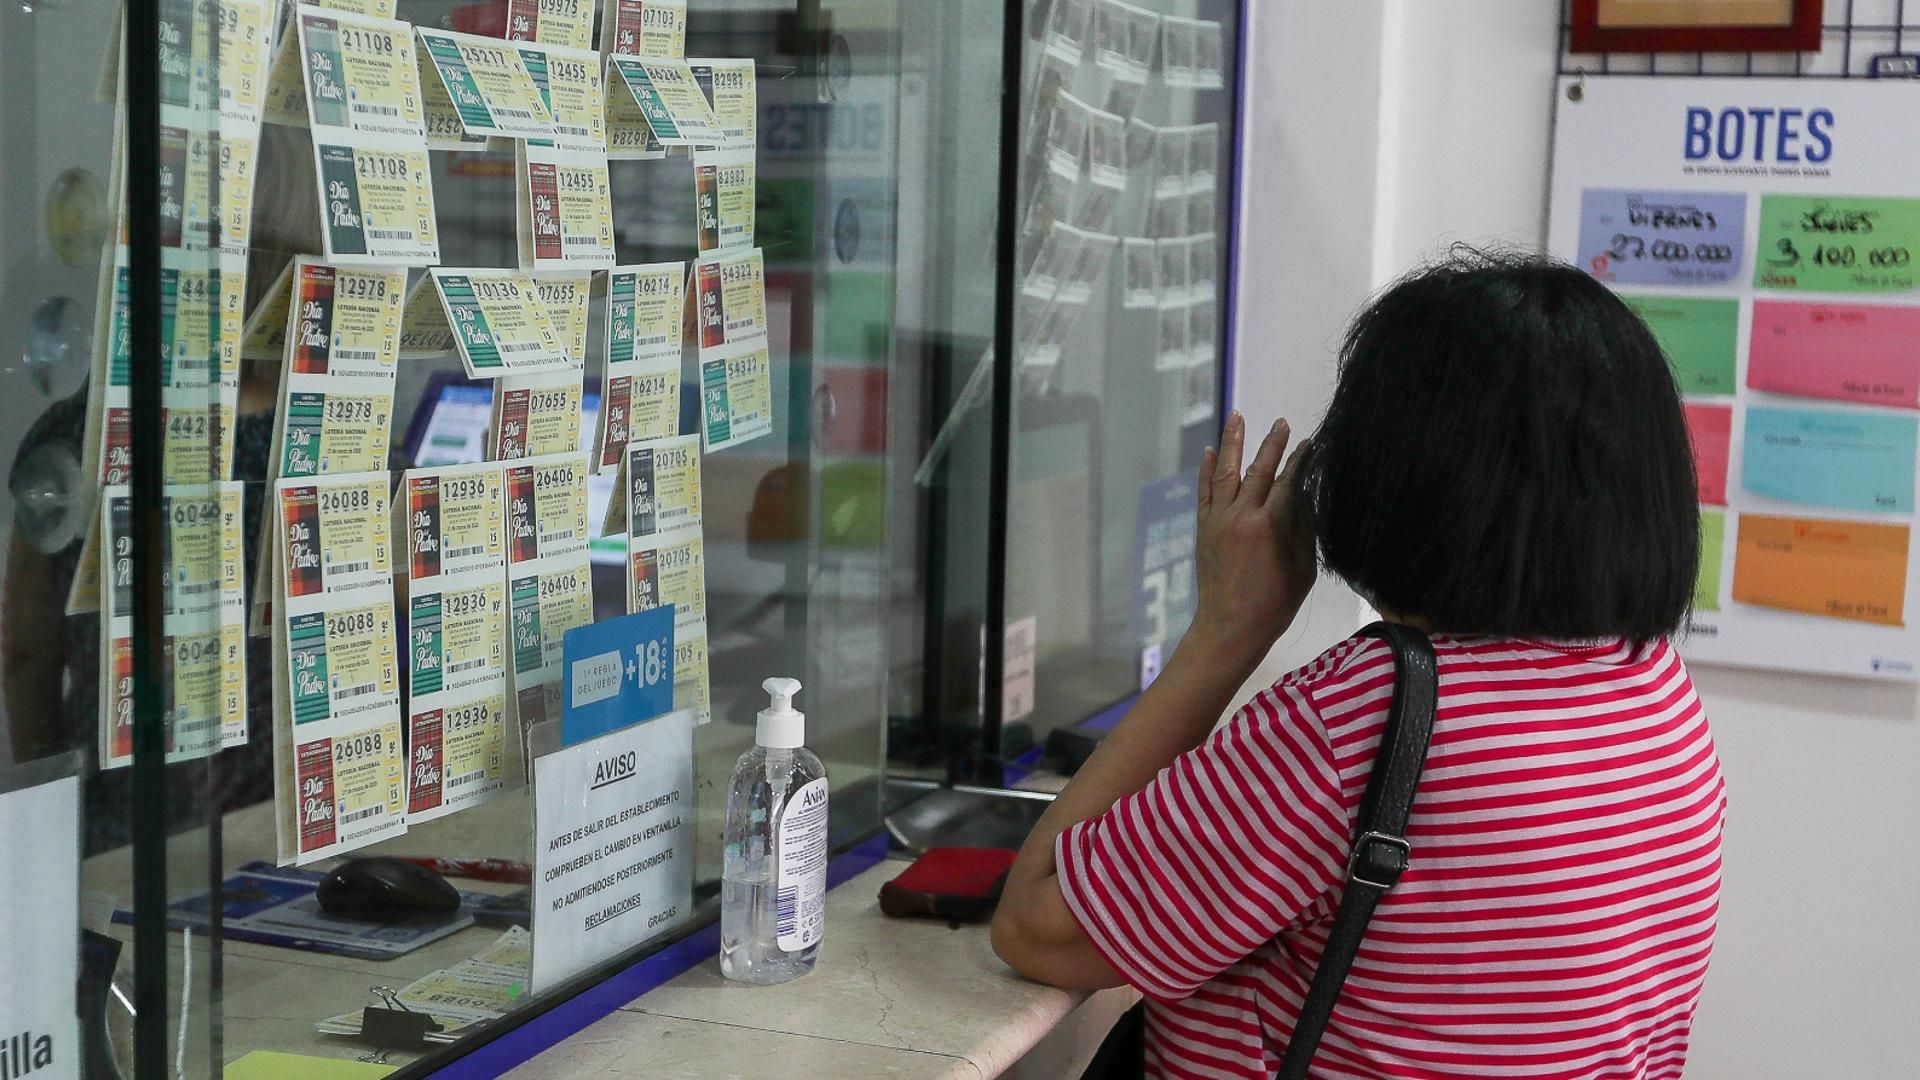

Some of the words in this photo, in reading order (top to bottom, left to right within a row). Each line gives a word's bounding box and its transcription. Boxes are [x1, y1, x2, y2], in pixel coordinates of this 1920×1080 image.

[643, 9, 674, 24] 07103
[343, 30, 393, 53] 21108
[461, 47, 506, 65] 25217
[551, 60, 586, 79] 12455
[1683, 105, 1835, 163] BOTES
[358, 156, 407, 176] 21108
[559, 171, 594, 188] 12455
[723, 264, 751, 281] 54322
[339, 276, 386, 297] 12978
[474, 282, 519, 297] 70136
[638, 278, 670, 295] 16214
[728, 358, 757, 376] 54322
[634, 377, 665, 394] 16214
[328, 401, 371, 418] 12978
[531, 392, 566, 409] 07655
[656, 450, 688, 467] 20705
[536, 467, 573, 487] 26406
[443, 479, 485, 499] 12936
[321, 490, 369, 510] 26088
[660, 548, 690, 567] 20705
[541, 574, 577, 596] 26406
[445, 592, 486, 612] 12936
[328, 612, 374, 635] 26088
[626, 639, 660, 689] +18
[446, 704, 488, 730] 12936
[335, 733, 382, 761] 26088
[594, 750, 636, 784] AVISO
[549, 833, 572, 852] ANTES
[573, 828, 583, 843] DE
[584, 820, 605, 838] SALIR
[605, 814, 619, 830] DEL
[620, 790, 680, 821] ESTABLECIMIENTO
[545, 852, 594, 882] COMPRUEBEN
[594, 849, 603, 862] EL
[604, 837, 631, 857] CAMBIO
[632, 832, 642, 845] EN
[643, 816, 681, 840] VENTANILLA
[552, 897, 563, 912] NO
[564, 873, 615, 907] ADMITIENDOSE
[616, 848, 673, 884] POSTERIORMENTE
[584, 893, 641, 928] RECLAMACIONES
[647, 906, 677, 928] GRACIAS
